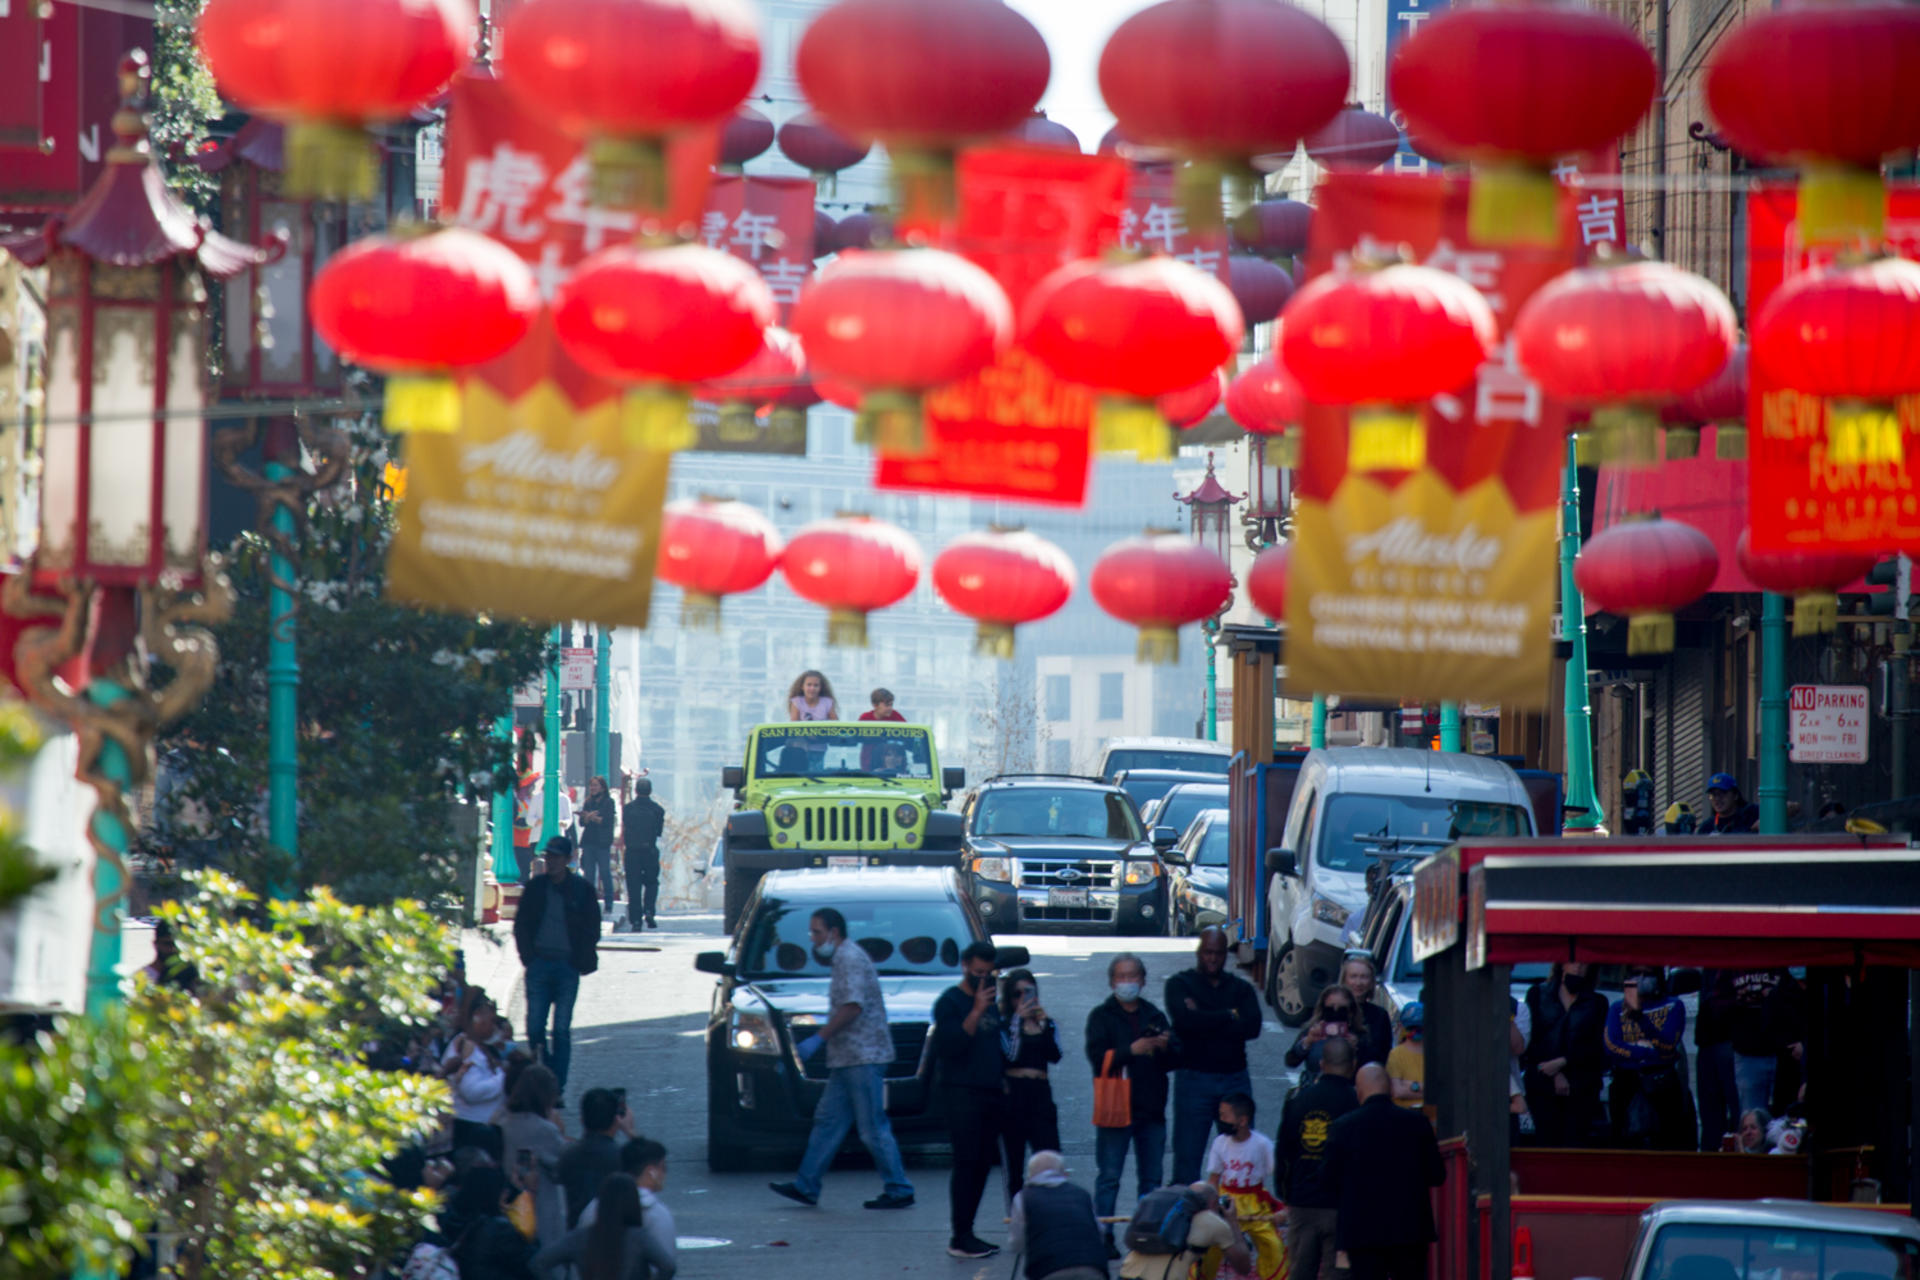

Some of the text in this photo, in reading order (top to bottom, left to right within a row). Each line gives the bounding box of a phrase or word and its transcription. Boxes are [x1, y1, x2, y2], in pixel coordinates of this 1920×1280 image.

[1577, 195, 1618, 245] 吉
[1793, 687, 1864, 709] NO PARKING
[761, 727, 924, 738] SAN FRANCISCO JEEP TOURS
[1799, 733, 1818, 745] MON
[1842, 733, 1857, 745] FRI
[1799, 751, 1861, 760] STREET CLEANING
